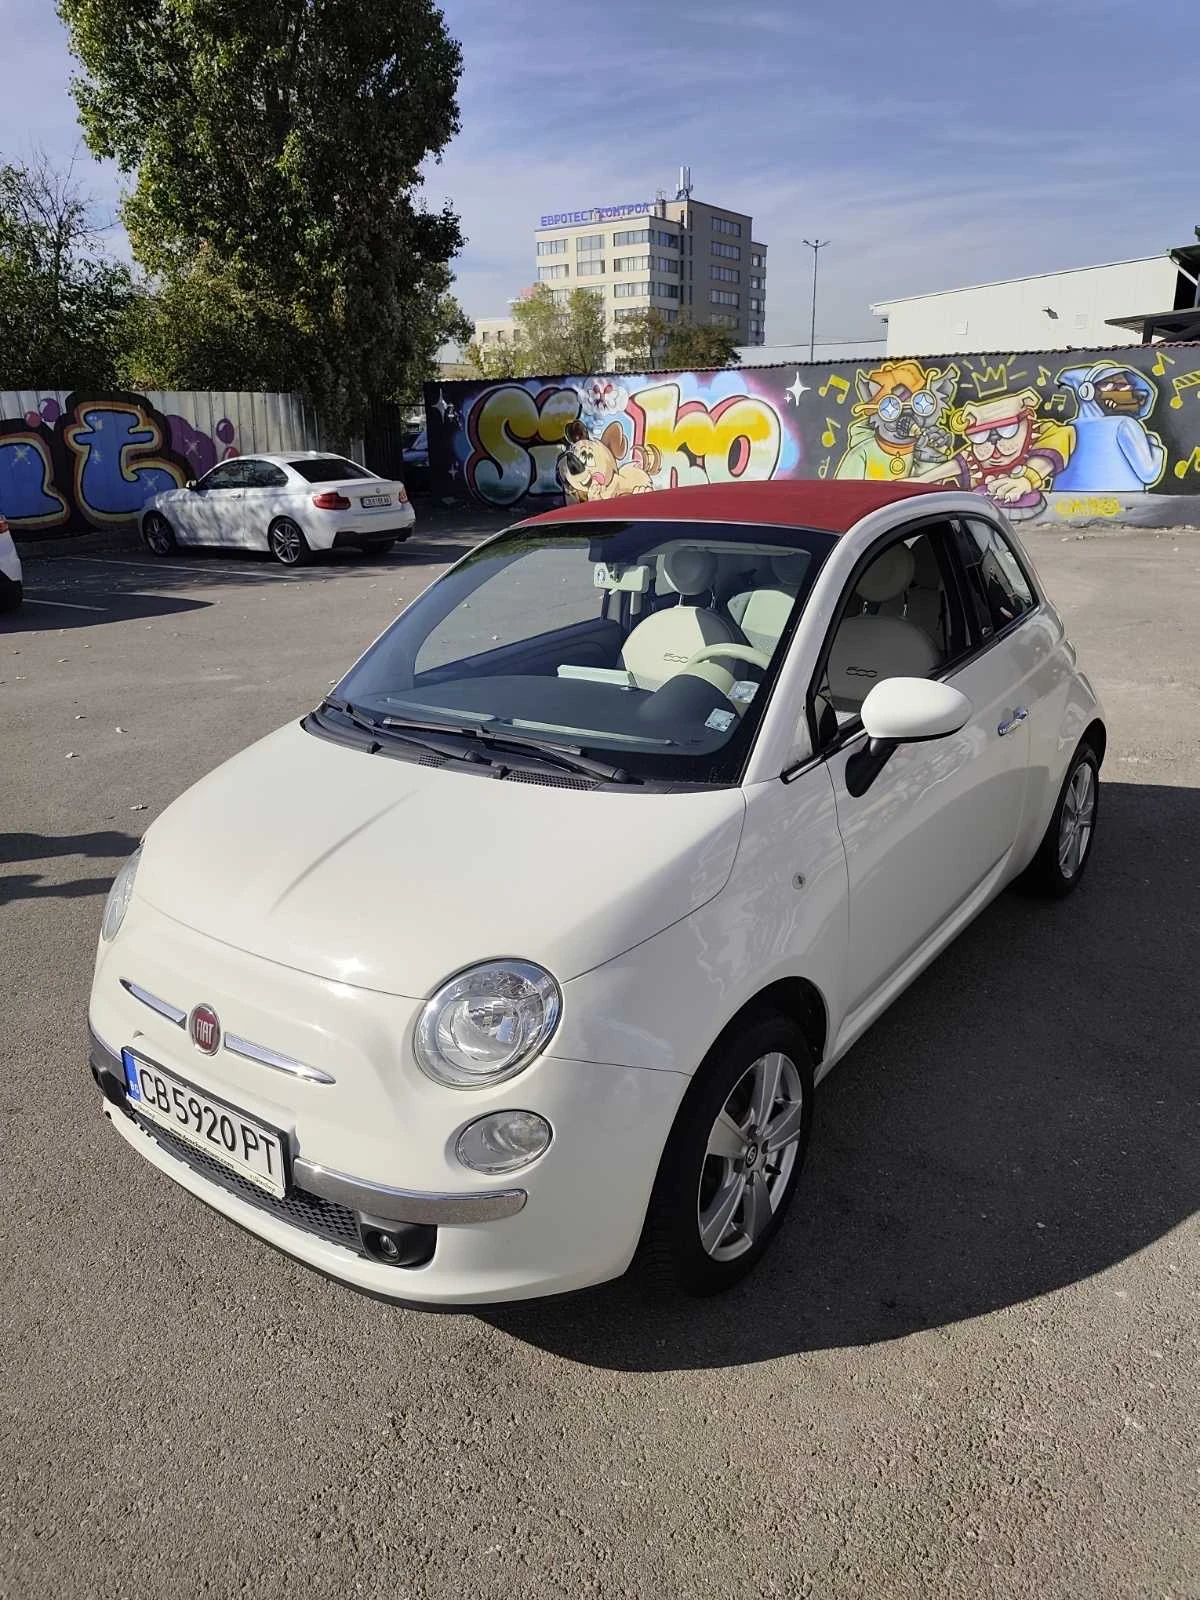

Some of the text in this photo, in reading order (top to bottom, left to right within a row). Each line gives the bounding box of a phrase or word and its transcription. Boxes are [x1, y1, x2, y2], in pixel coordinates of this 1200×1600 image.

[540, 209, 594, 227] ЕВРОТЕСТ
[846, 666, 878, 678] 500
[196, 1017, 215, 1045] FIAT
[172, 1088, 237, 1152] 5920
[240, 1124, 276, 1175] PT
